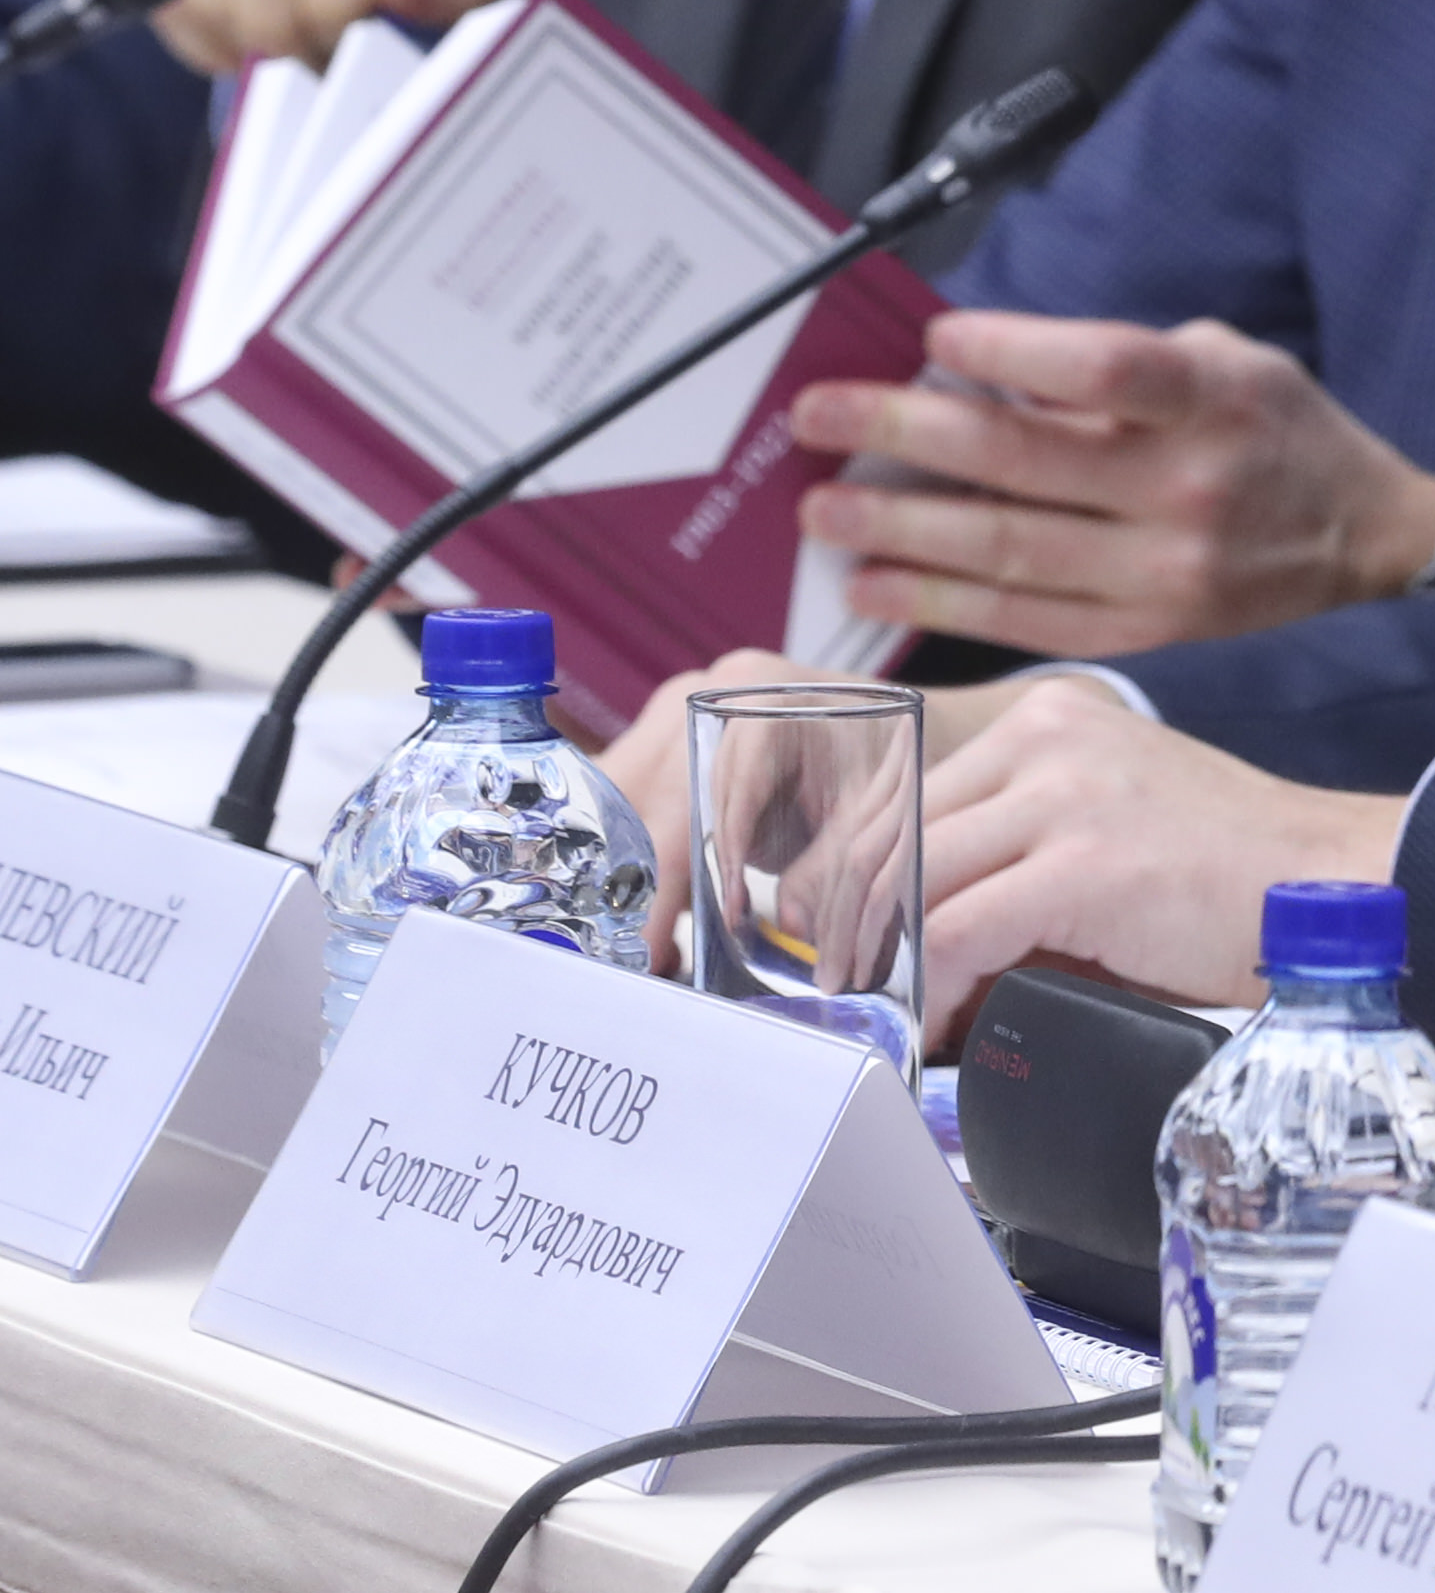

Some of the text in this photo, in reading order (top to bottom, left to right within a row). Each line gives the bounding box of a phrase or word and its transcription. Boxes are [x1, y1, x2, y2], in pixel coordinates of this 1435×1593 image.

[0, 863, 185, 985] ЛЕВСКИЙ
[0, 1003, 110, 1100] Ильич
[484, 1033, 659, 1145] КУЧКОВ
[336, 1117, 490, 1221] Георгий
[473, 1163, 685, 1295] Эдуардович
